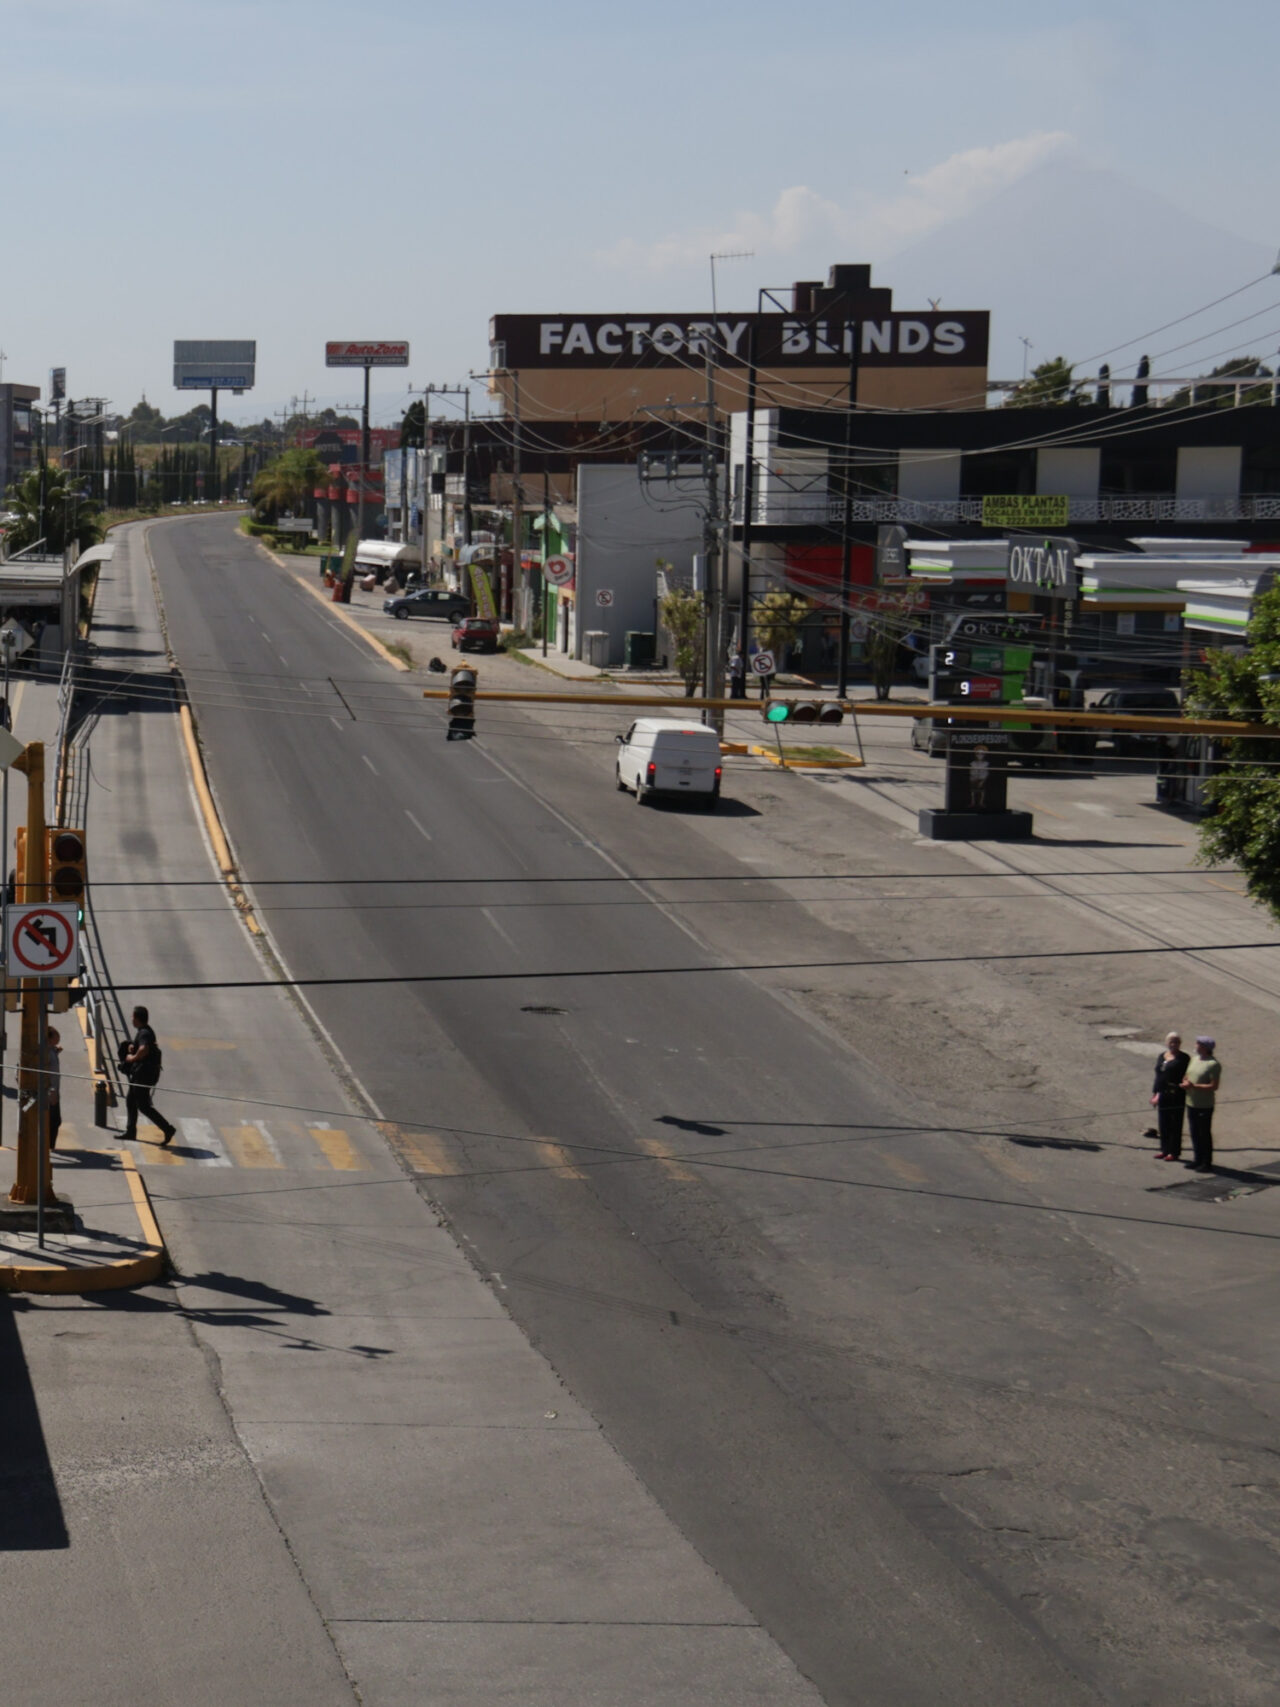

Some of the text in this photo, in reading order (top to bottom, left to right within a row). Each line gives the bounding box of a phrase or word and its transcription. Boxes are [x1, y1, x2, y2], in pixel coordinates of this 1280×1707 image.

[538, 320, 966, 355] FACTORY BLINDS
[345, 342, 406, 356] AutoZone
[984, 496, 1065, 508] AMBAS PLANTAS
[983, 508, 1065, 517] LOCALES EN RENTA
[1064, 597, 1073, 638] ESEL
[960, 681, 970, 695] 9
